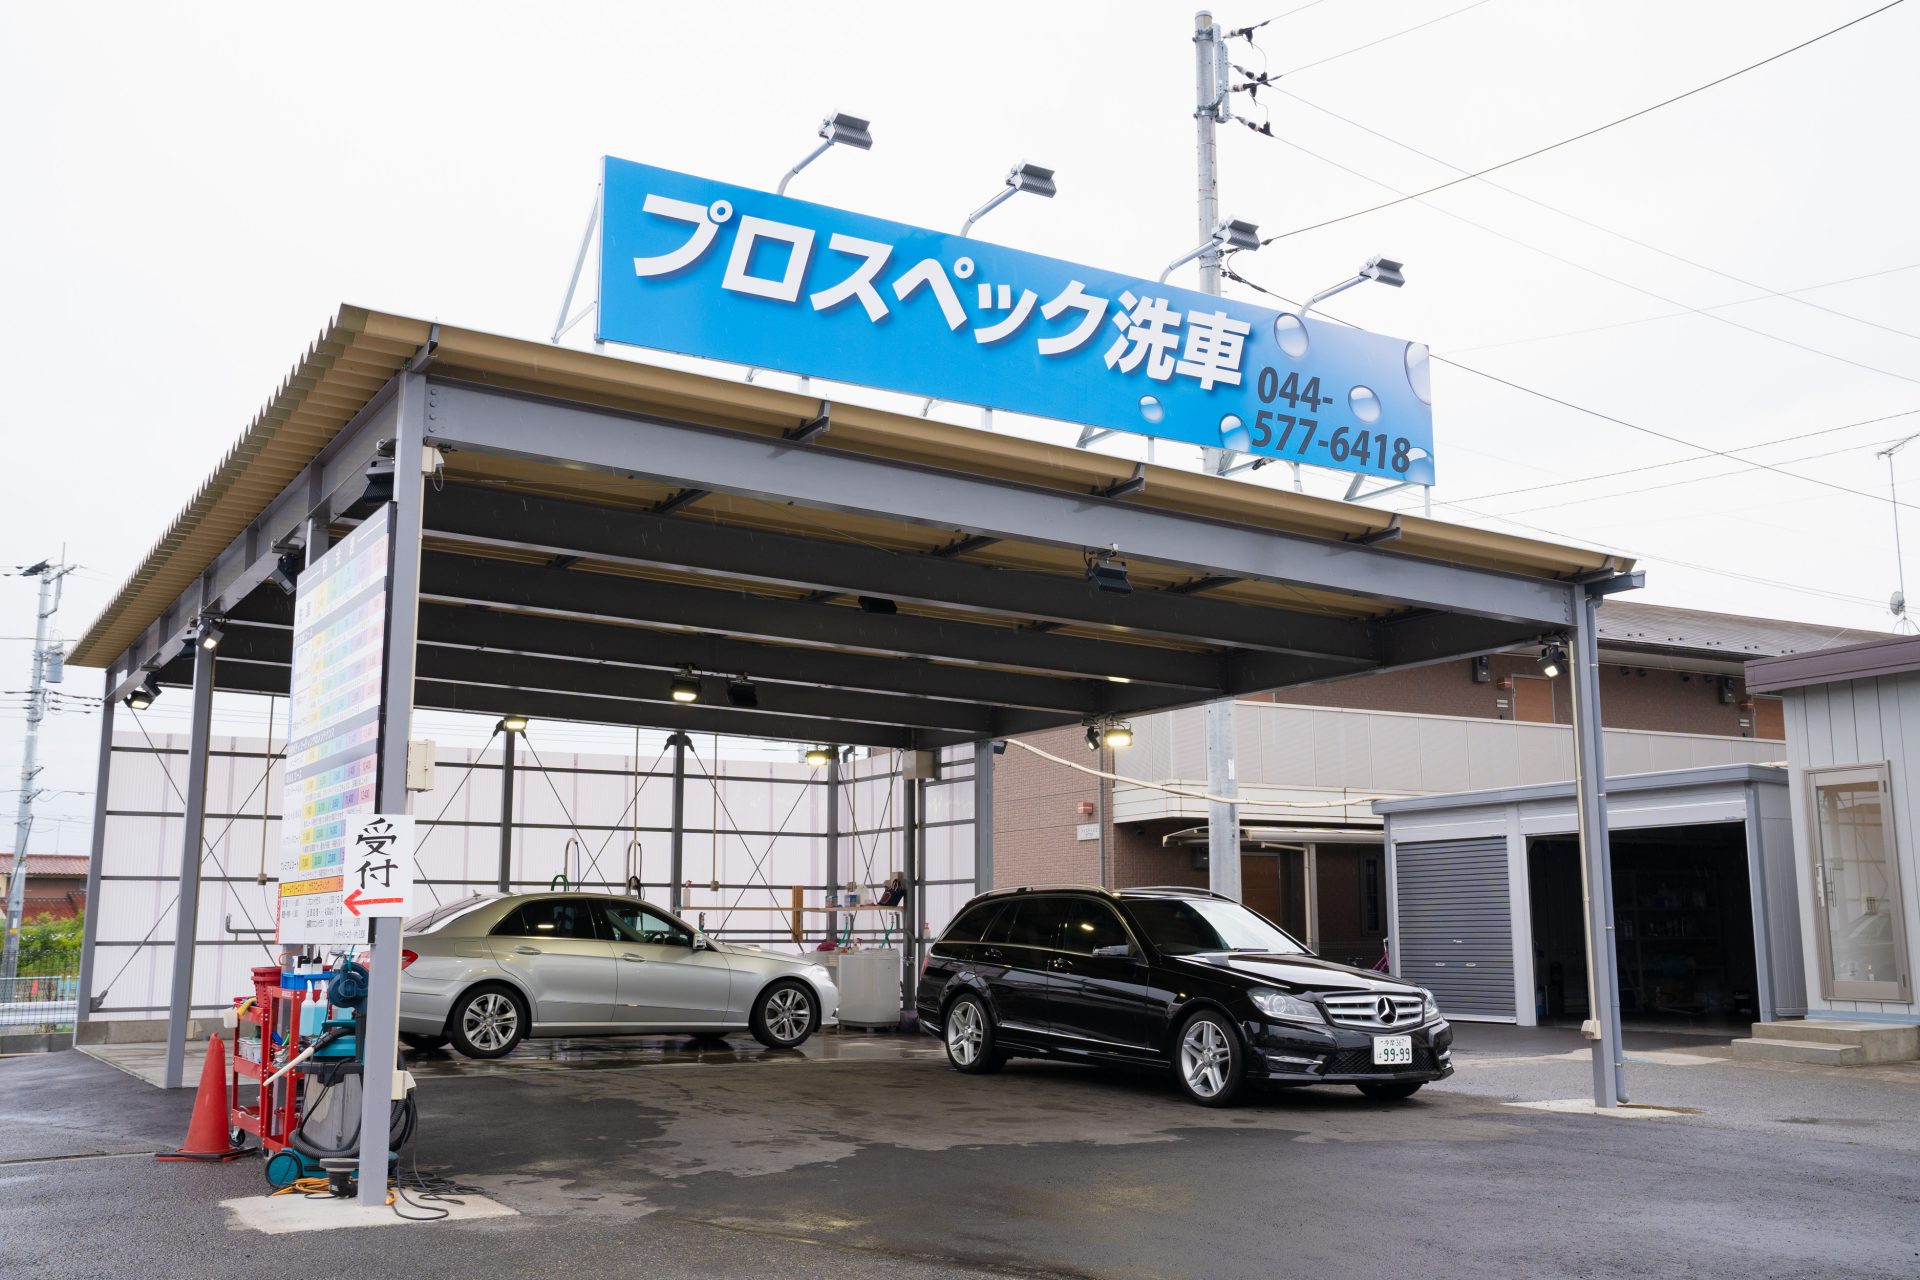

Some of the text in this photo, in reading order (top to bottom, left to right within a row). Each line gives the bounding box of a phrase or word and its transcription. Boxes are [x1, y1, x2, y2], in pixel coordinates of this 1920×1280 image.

[633, 193, 1251, 390] プロスペック洗車
[1257, 366, 1334, 412] 044-
[1251, 410, 1411, 473] 577-6418
[355, 817, 399, 889] 受付
[1383, 1048, 1410, 1062] 99-99
